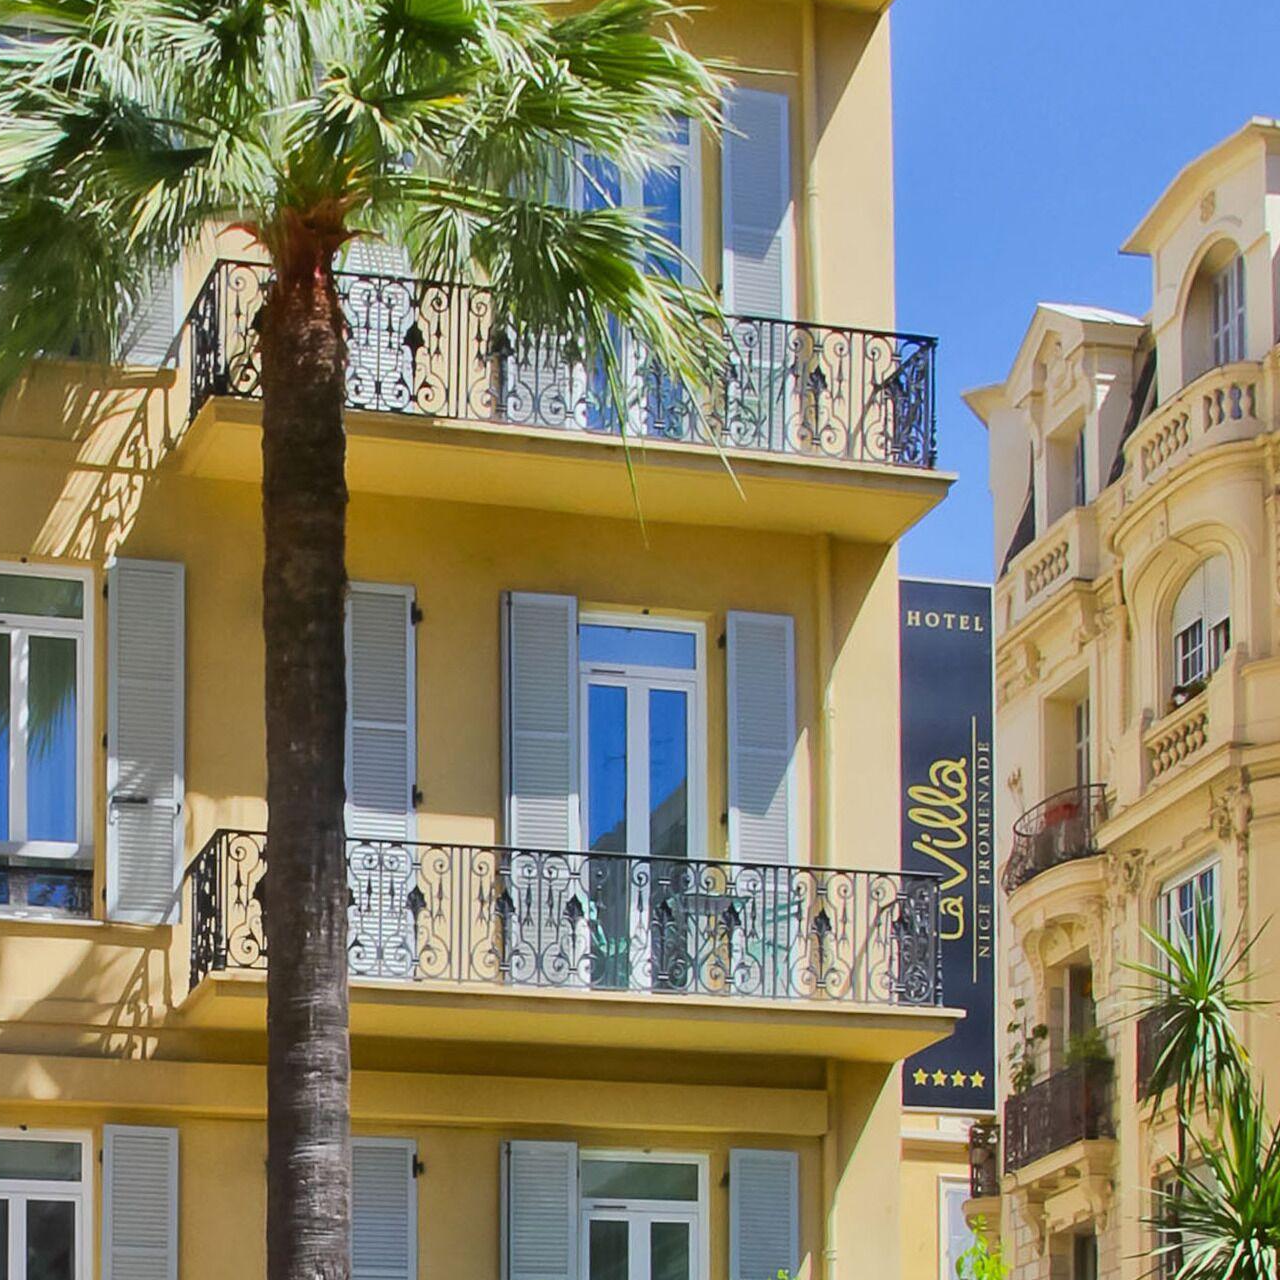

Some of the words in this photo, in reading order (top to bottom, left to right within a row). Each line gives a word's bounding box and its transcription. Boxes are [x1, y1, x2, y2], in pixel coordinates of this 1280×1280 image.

[906, 610, 984, 632] HOTEL
[977, 741, 991, 885] PROMENADE
[978, 904, 991, 958] NICE
